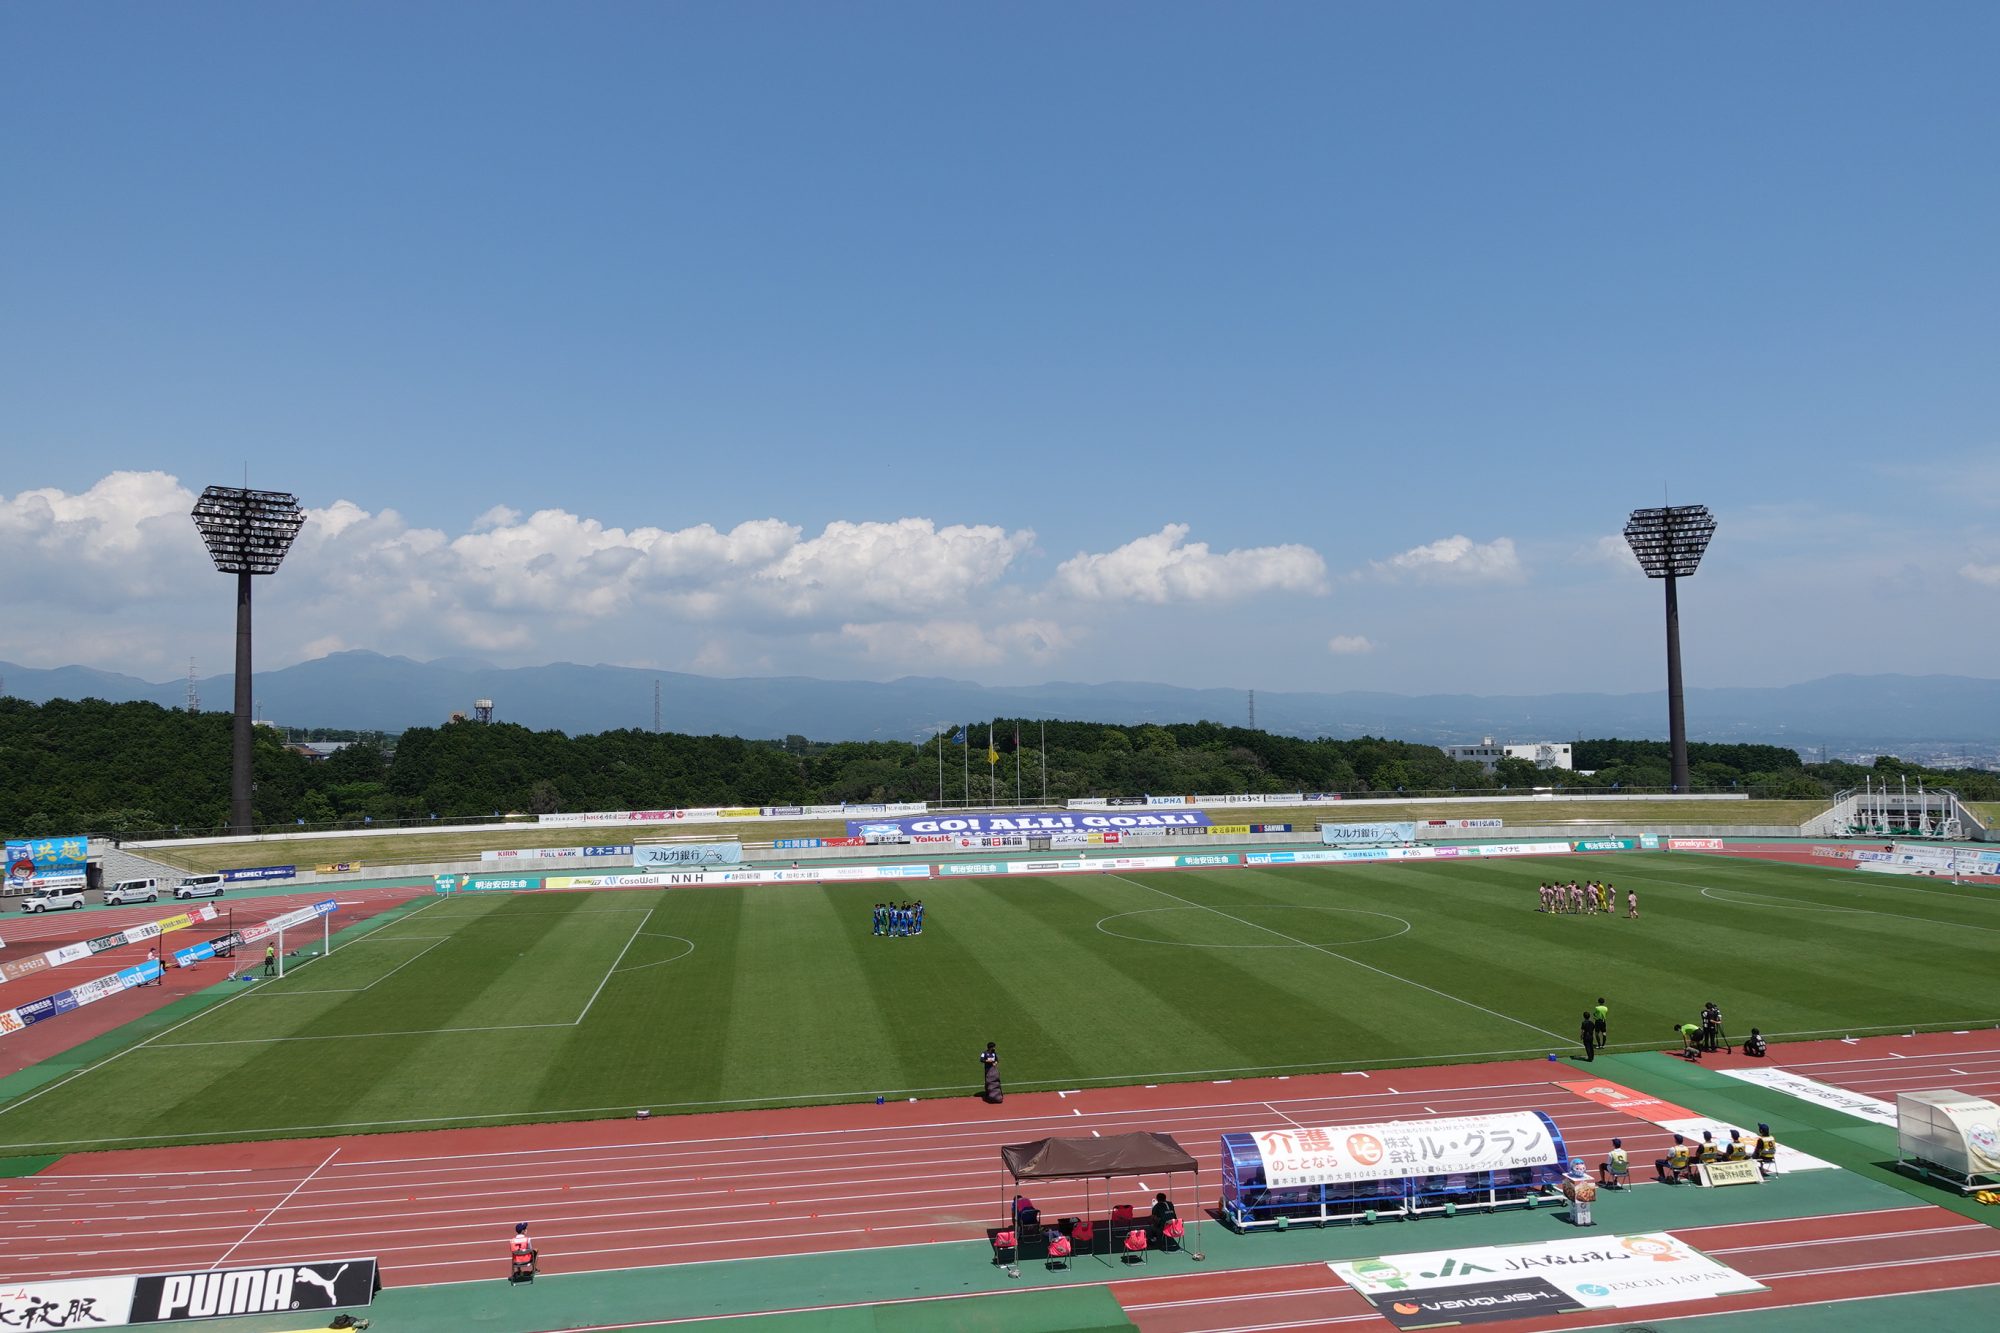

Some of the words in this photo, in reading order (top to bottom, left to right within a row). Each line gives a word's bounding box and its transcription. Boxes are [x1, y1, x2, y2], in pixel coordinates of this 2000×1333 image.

[911, 818, 981, 832] GO!
[990, 817, 1075, 830] ALL!
[1082, 814, 1198, 827] GOAL!
[1264, 824, 1285, 832] SANWA
[1334, 828, 1378, 838] スルガ銀行
[913, 835, 952, 844] Yakult
[981, 837, 1022, 847] 朝日新聞
[649, 851, 700, 862] スルガ銀行
[1185, 856, 1229, 865] 明治安田生命
[950, 865, 997, 873] 明治安田生命
[234, 871, 263, 879] RESPECT
[475, 880, 527, 889] 明治安田生命
[1261, 1129, 1335, 1155] 介護
[1384, 1136, 1414, 1148] 株式
[1419, 1127, 1542, 1161] ル・グラン
[1389, 1149, 1417, 1164] 会社
[1272, 1155, 1338, 1172] のことなら
[1609, 1279, 1669, 1292] EXCEL
[1671, 1271, 1733, 1287] JAPAN
[157, 1268, 295, 1320] PUMA
